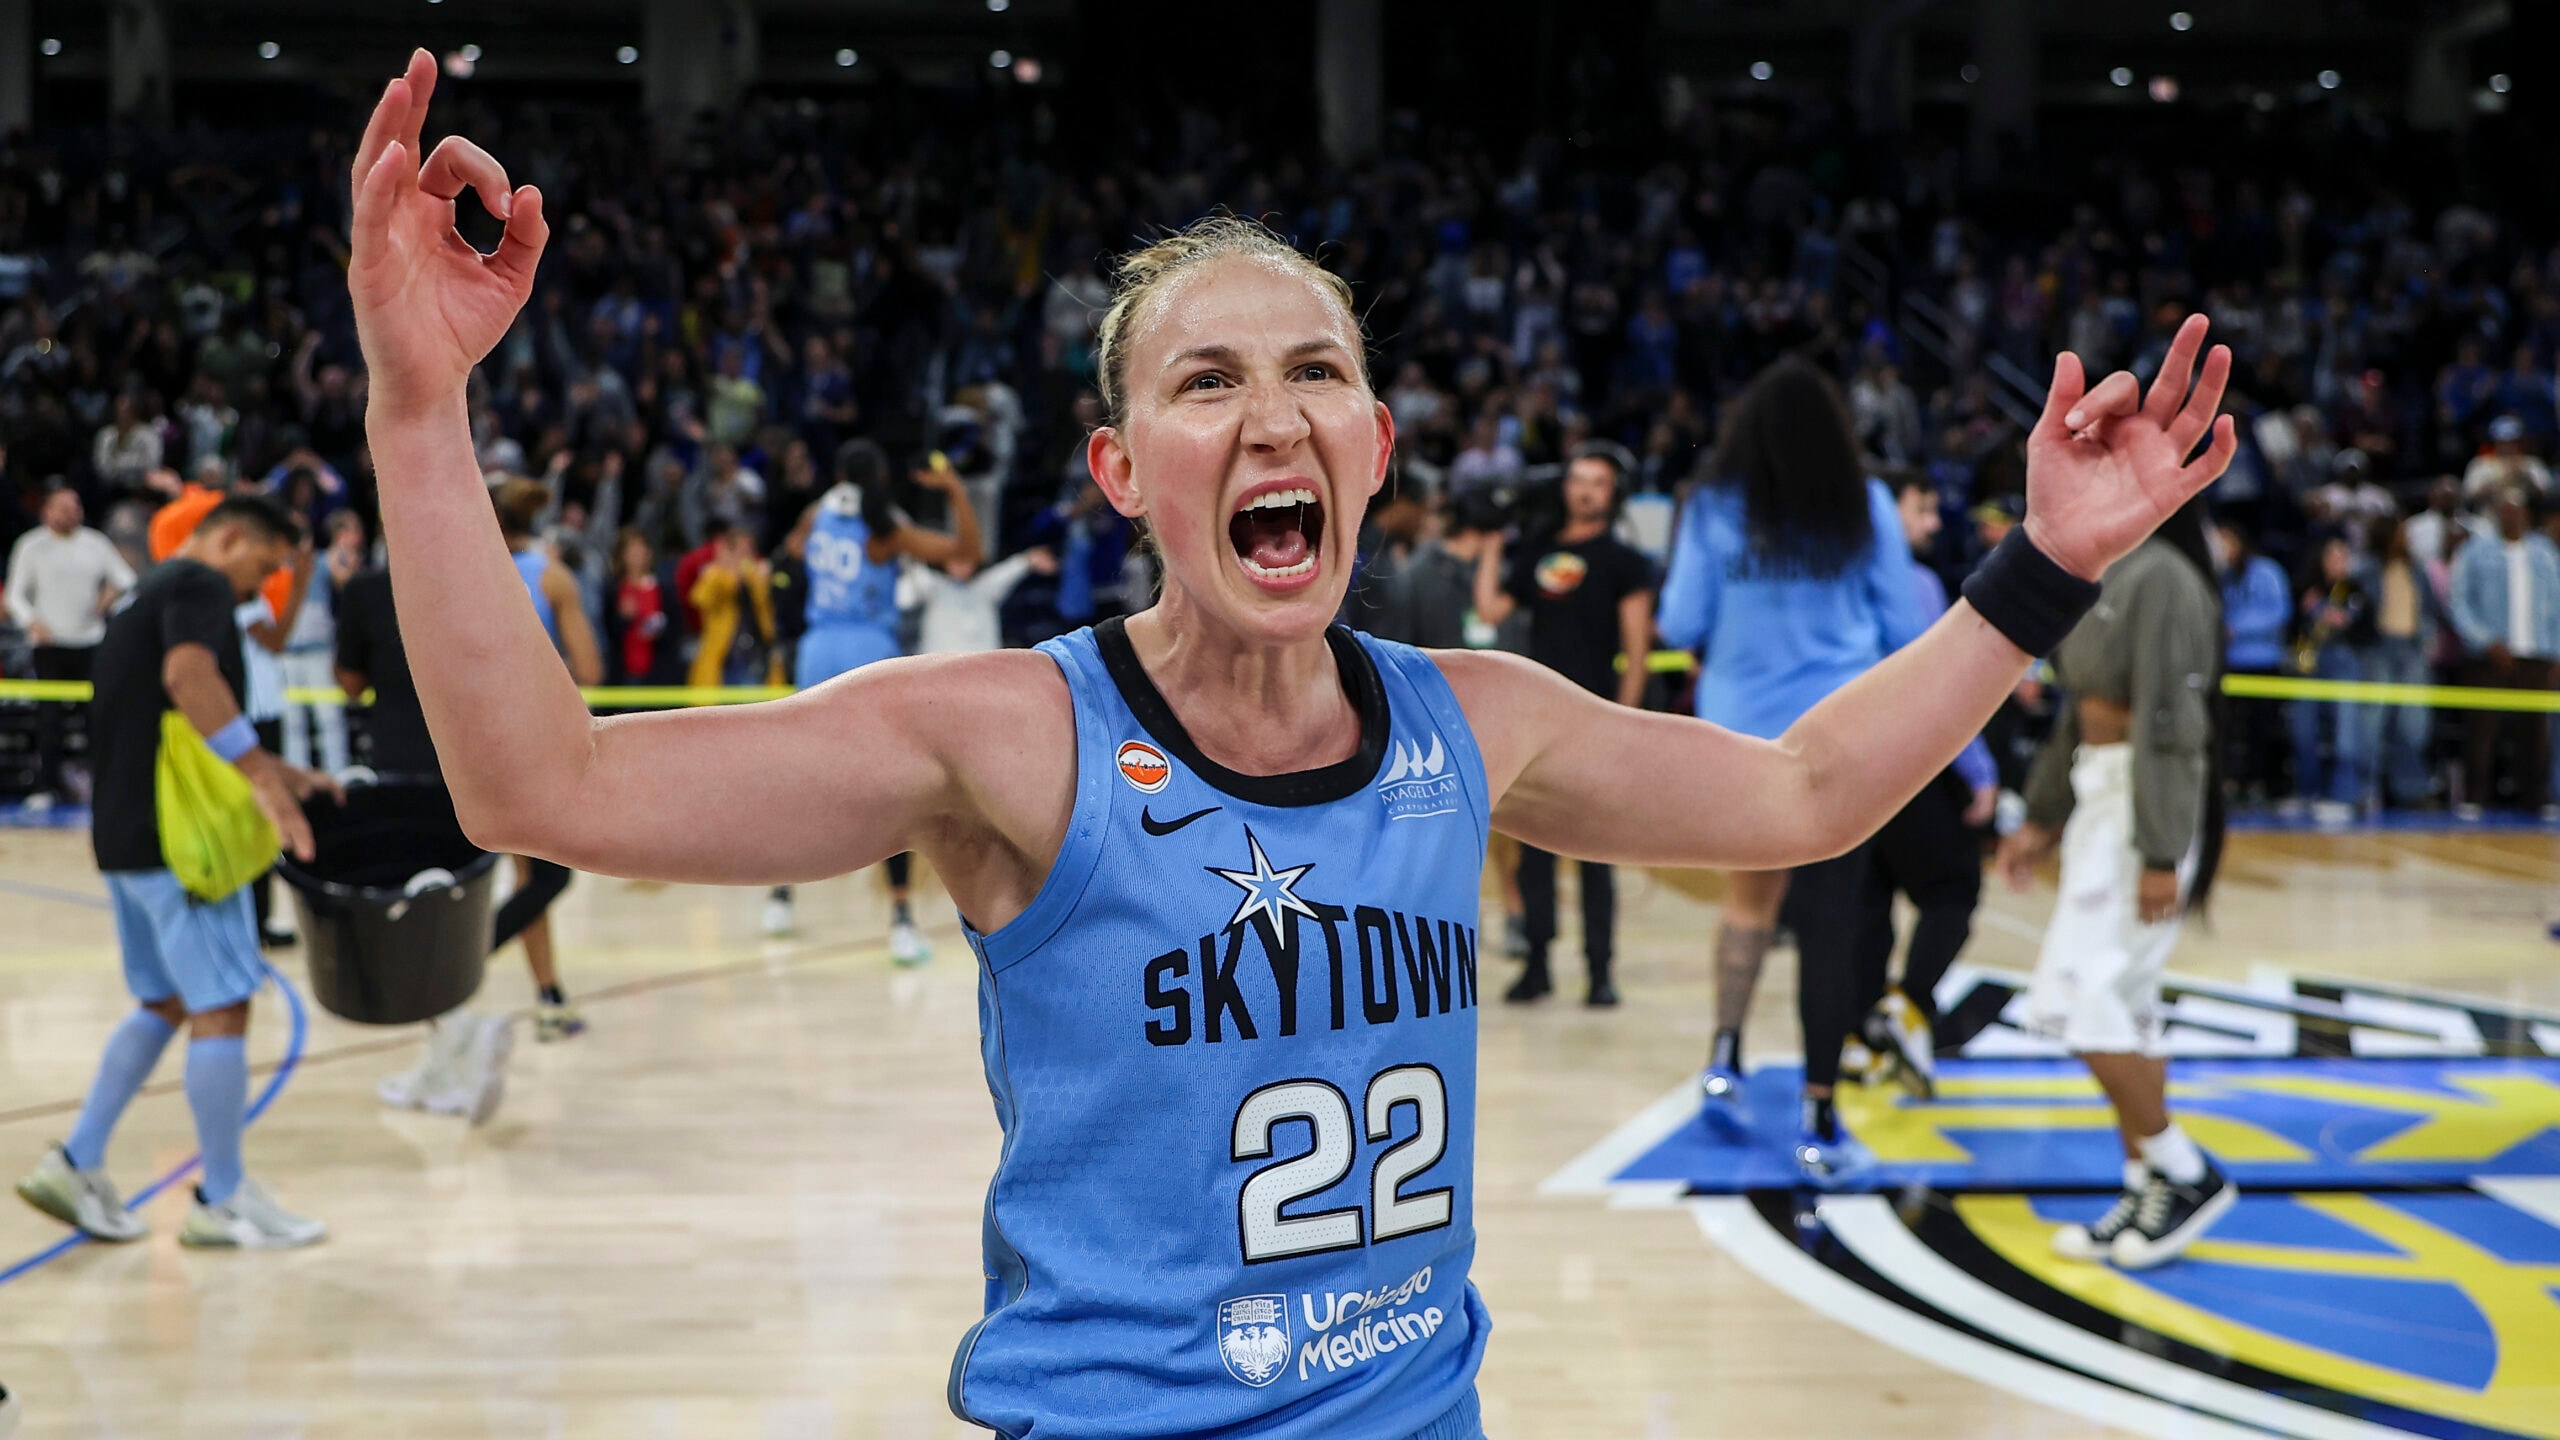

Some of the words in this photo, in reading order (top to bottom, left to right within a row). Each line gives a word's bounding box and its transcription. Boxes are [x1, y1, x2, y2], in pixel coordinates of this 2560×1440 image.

[1381, 779, 1457, 805] MAGELLAN
[1144, 898, 1477, 1046] SKYTOWN
[1230, 1062, 1453, 1266] 22
[1302, 1265, 1432, 1331] UChicago
[1298, 1306, 1444, 1381] Medicine
